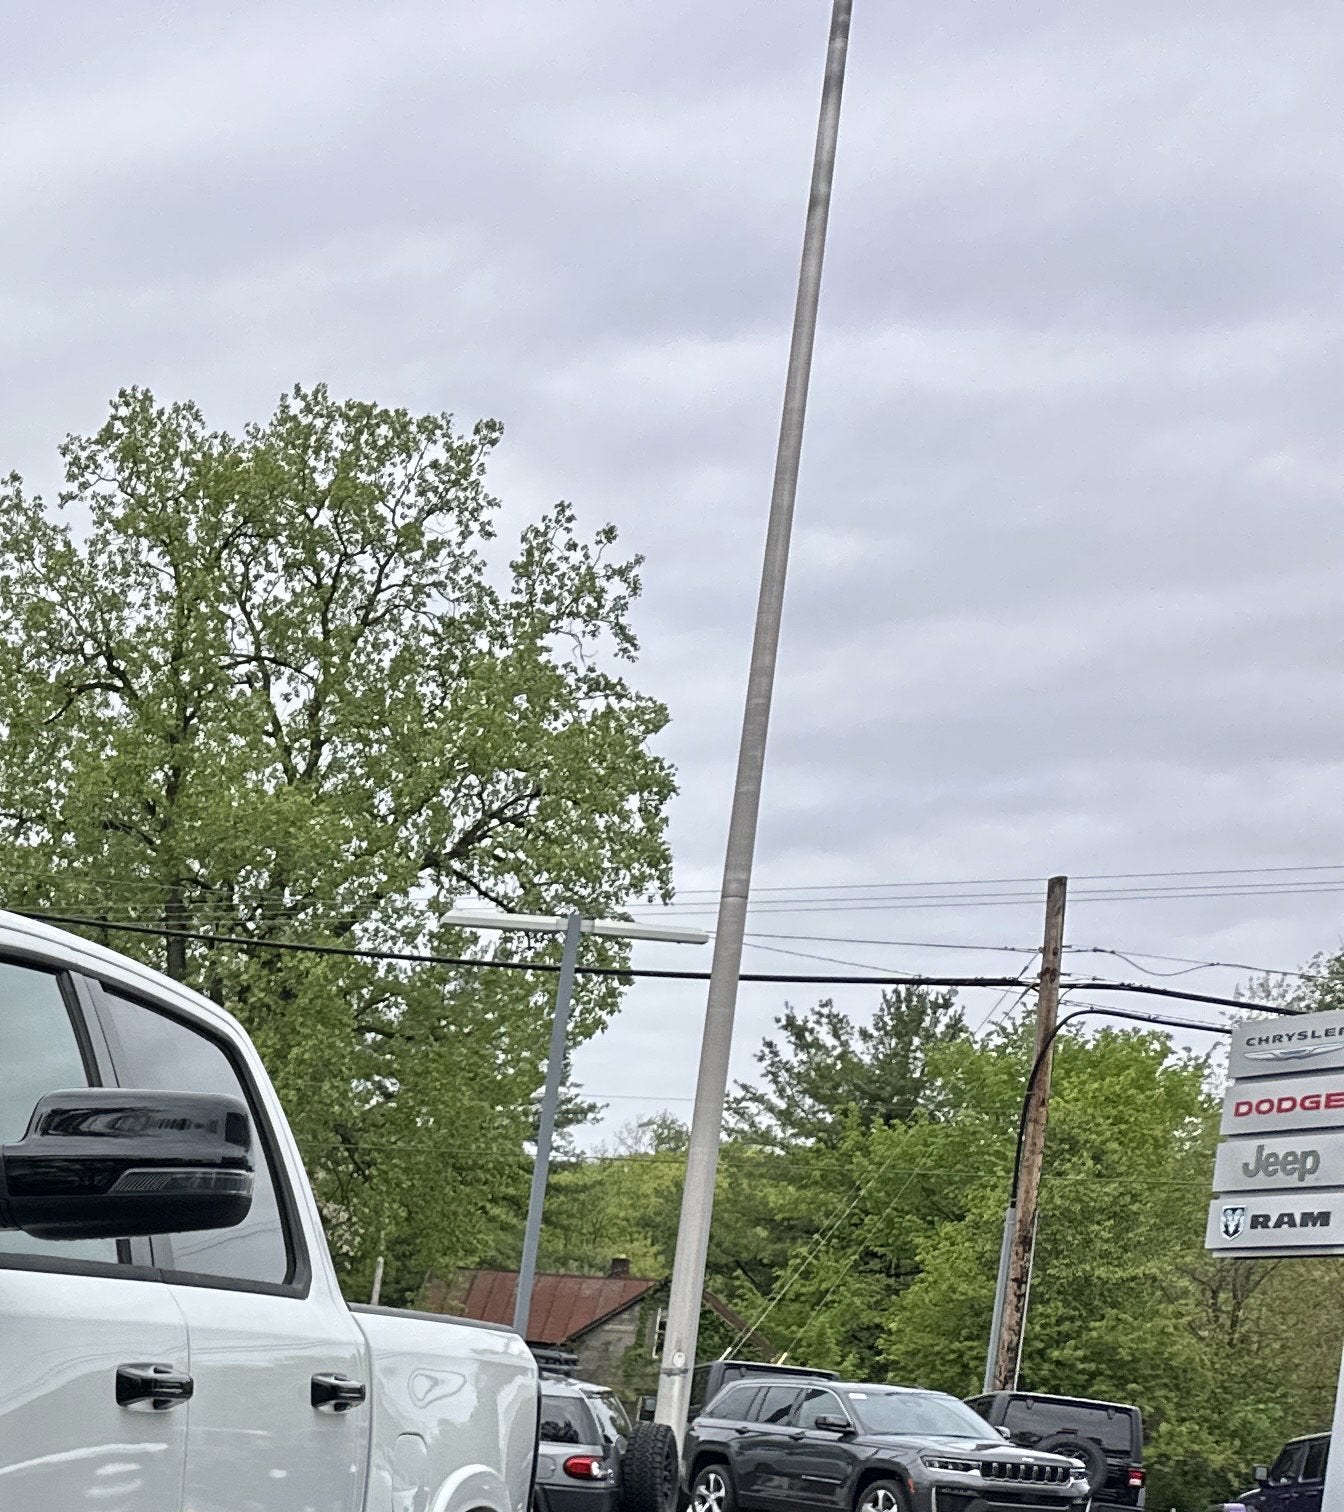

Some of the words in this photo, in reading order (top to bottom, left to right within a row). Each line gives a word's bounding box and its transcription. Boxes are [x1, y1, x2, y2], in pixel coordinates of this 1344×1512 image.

[1234, 1091, 1344, 1118] DODGE
[1242, 1144, 1320, 1182] Jeep
[1250, 1211, 1332, 1230] RAM
